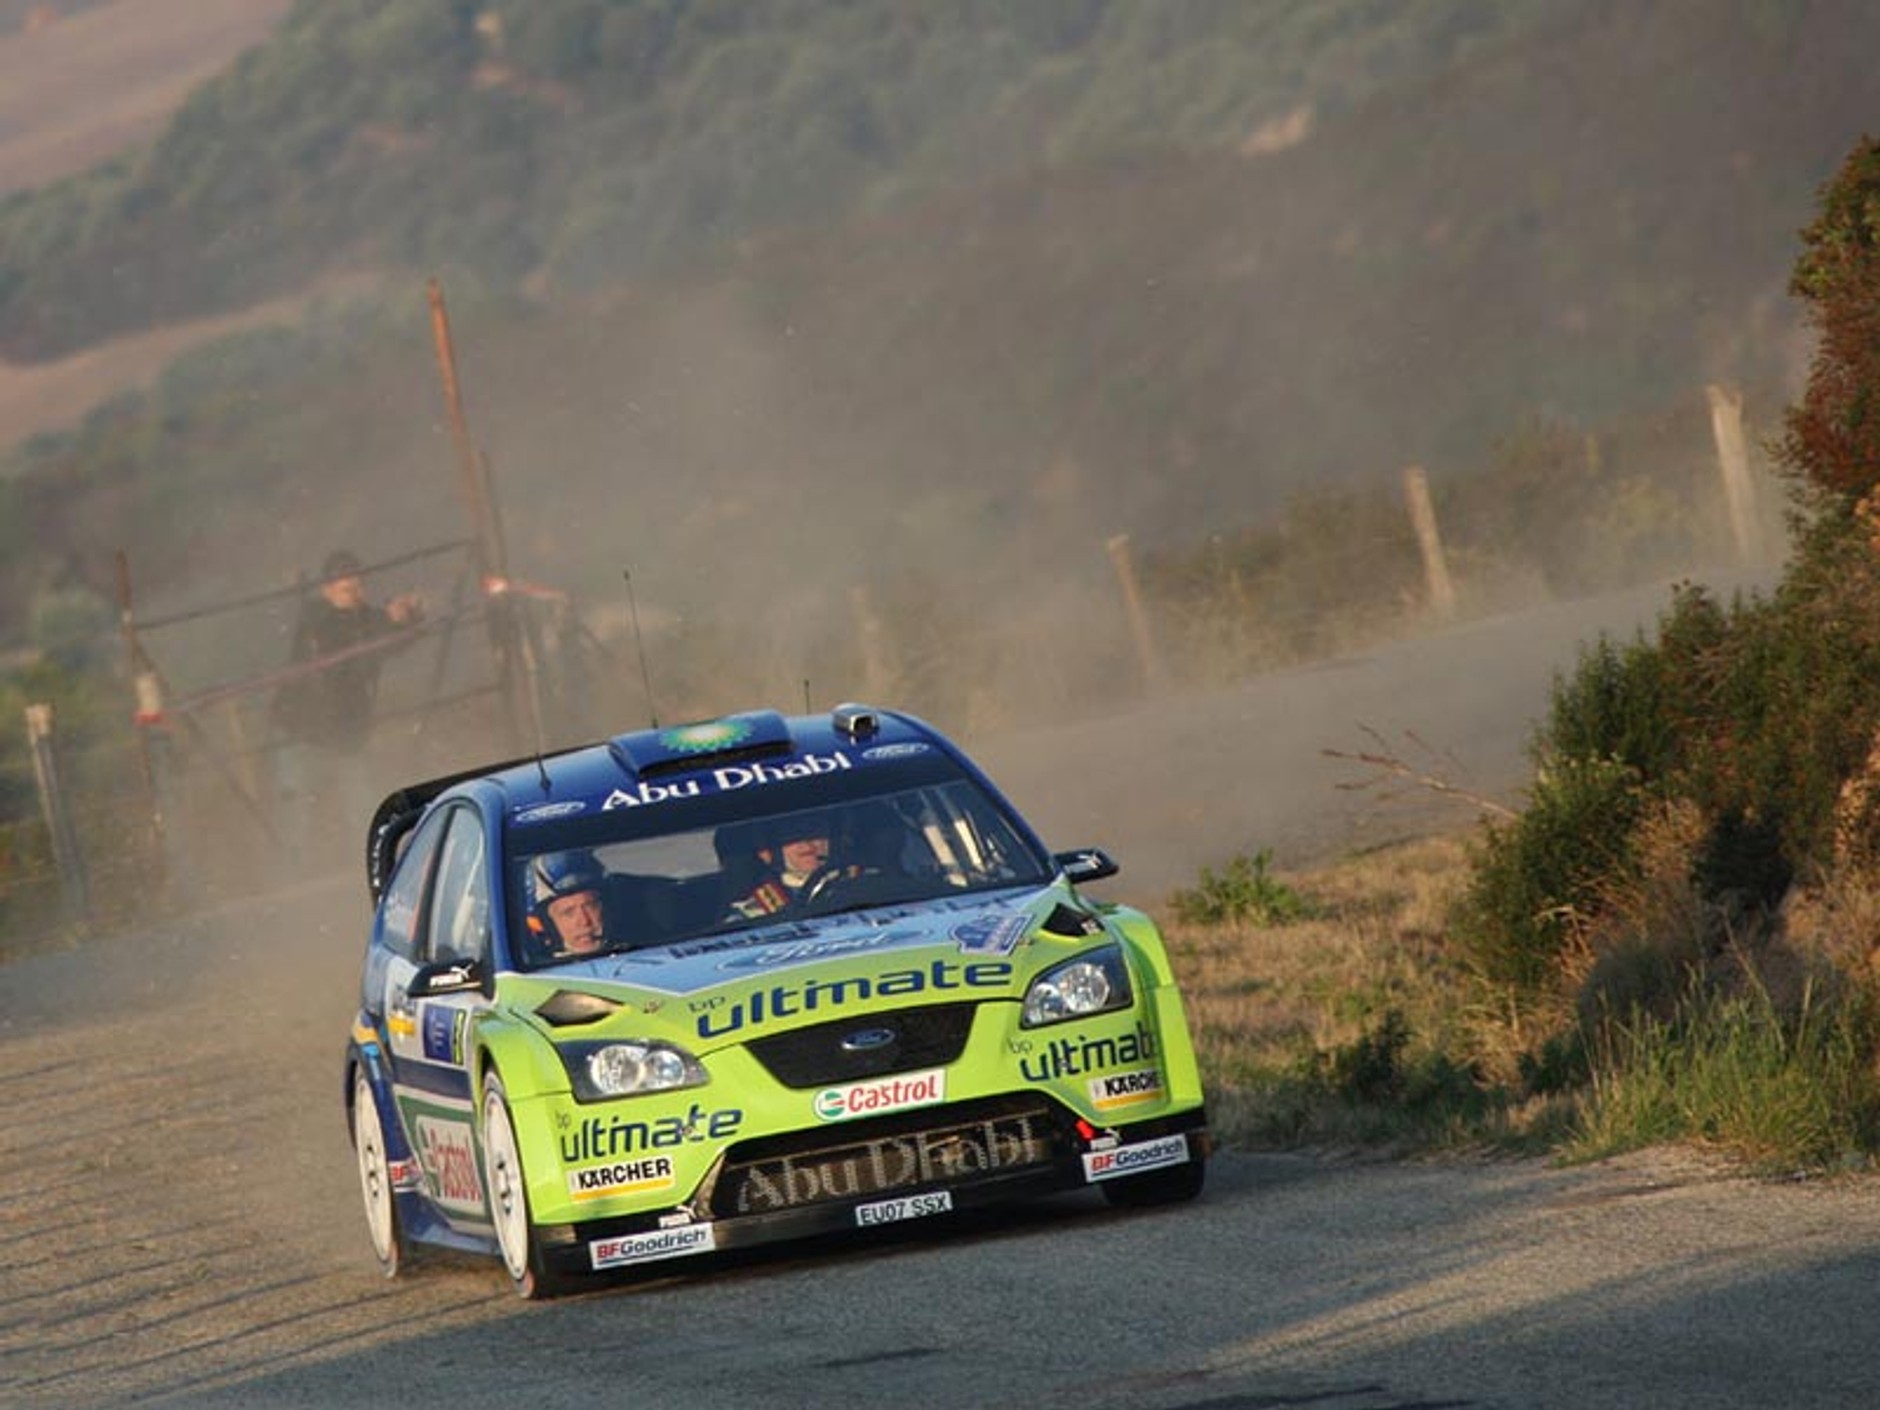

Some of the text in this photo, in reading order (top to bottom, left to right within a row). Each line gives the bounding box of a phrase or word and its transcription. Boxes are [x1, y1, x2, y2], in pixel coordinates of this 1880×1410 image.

[602, 782, 701, 811] Abu
[714, 752, 853, 790] Dhabi
[688, 995, 726, 1013] bp
[696, 960, 1013, 1039] ultimate
[1019, 1020, 1155, 1082] ultimat
[848, 1074, 937, 1113] Castrol
[561, 1104, 743, 1162] ultimate
[1091, 1141, 1183, 1172] BFGoodrich
[737, 1156, 860, 1213] Abu
[860, 1201, 906, 1226] EU07
[596, 1229, 707, 1259] BFGoodrich
